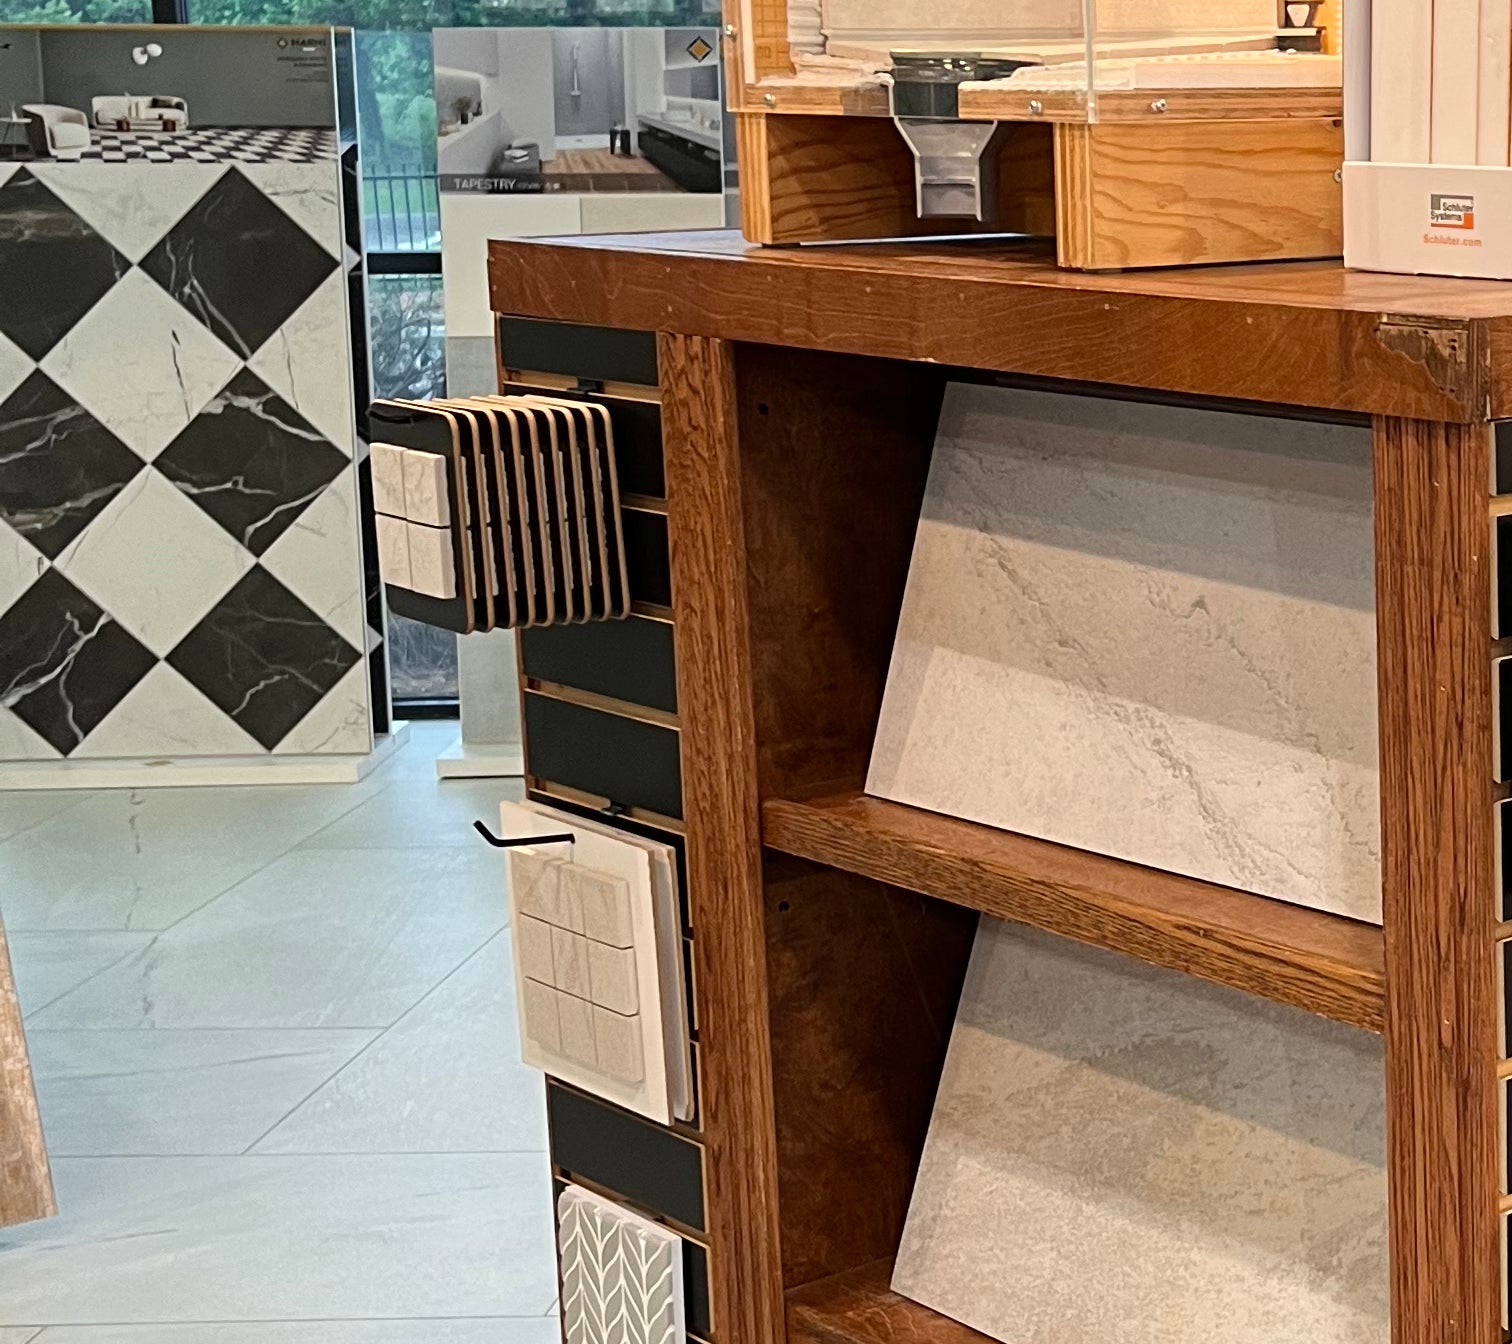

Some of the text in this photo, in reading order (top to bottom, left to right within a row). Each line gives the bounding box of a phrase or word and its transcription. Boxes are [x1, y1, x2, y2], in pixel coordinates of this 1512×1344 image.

[454, 178, 517, 190] TAPESTRY
[1442, 201, 1474, 212] Schluter
[1430, 212, 1462, 222] Systems
[1423, 233, 1482, 247] Schluter.com
